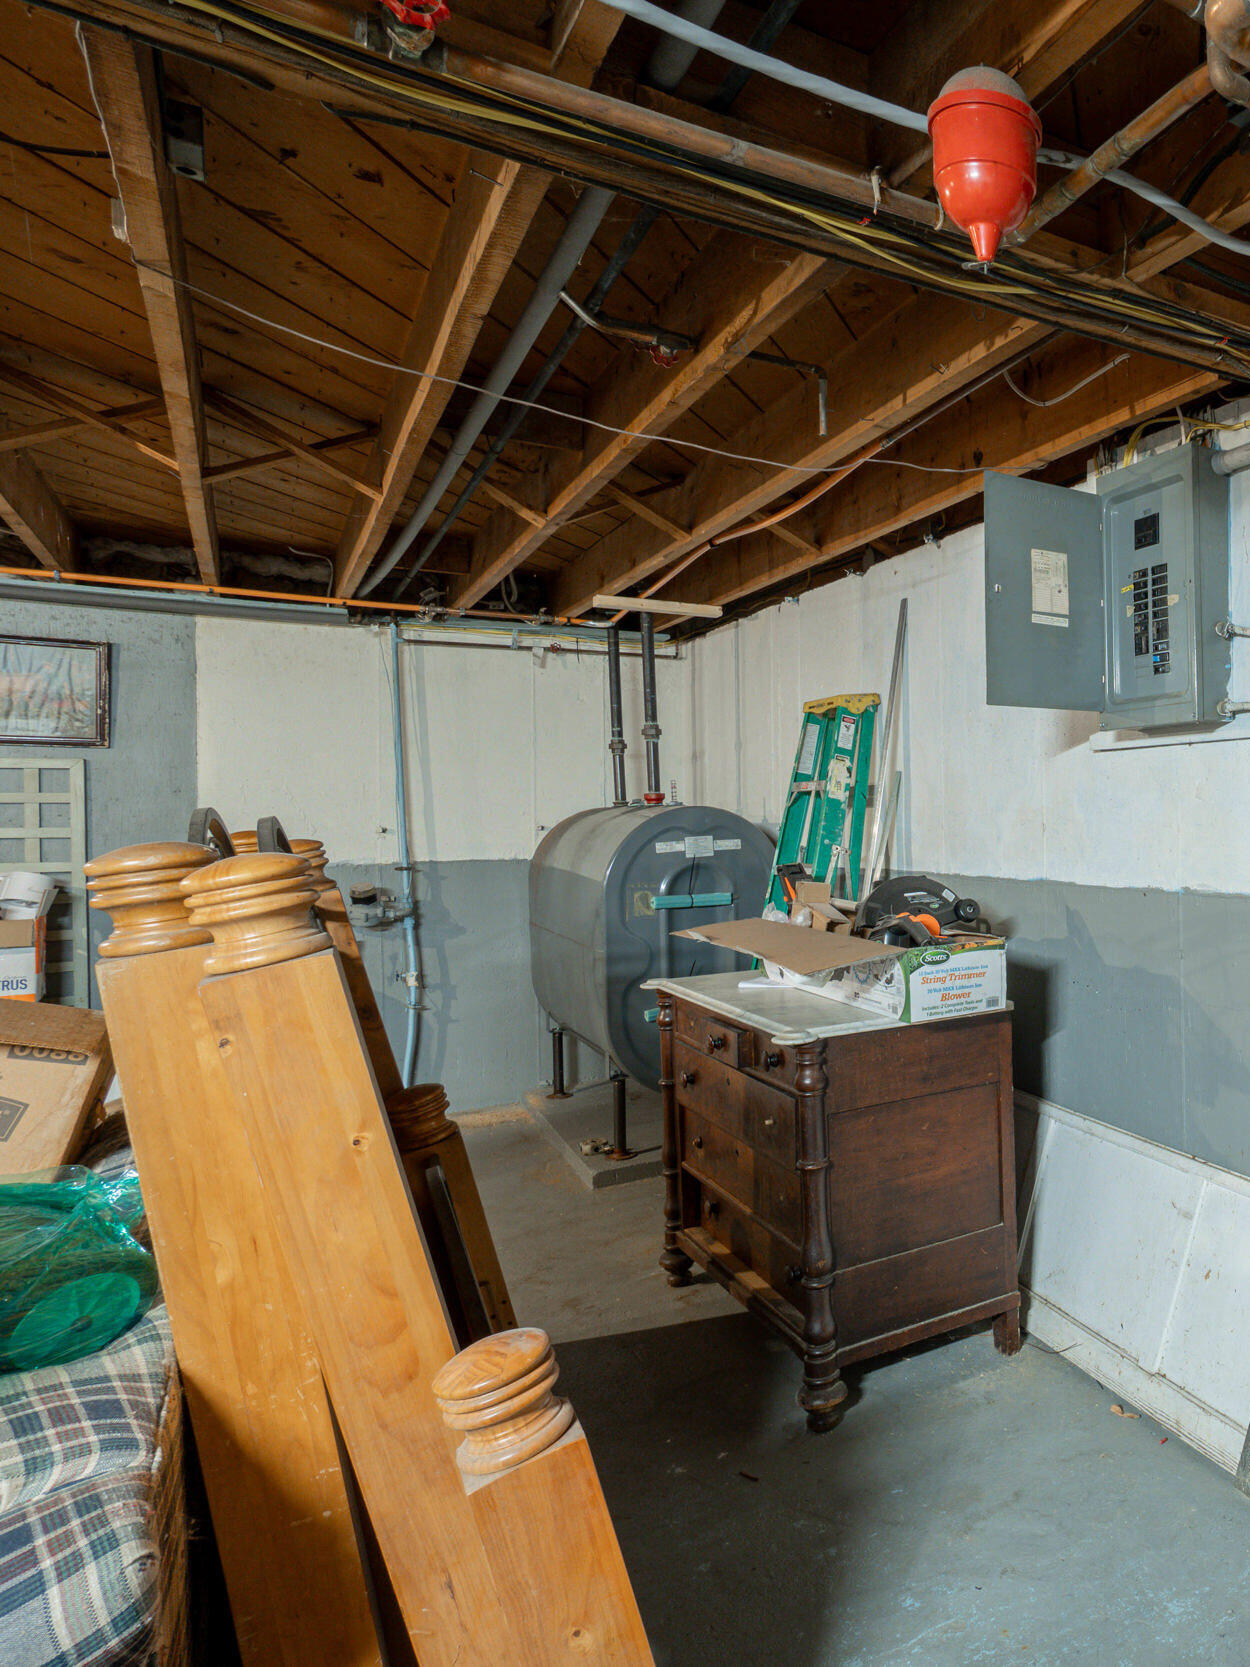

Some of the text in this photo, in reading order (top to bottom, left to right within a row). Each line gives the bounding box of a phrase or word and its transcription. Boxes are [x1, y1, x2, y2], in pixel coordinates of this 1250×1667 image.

[924, 954, 948, 962] Scotts
[921, 971, 987, 985] String Trimmer
[0, 978, 28, 991] RUS
[940, 991, 973, 1002] Blower
